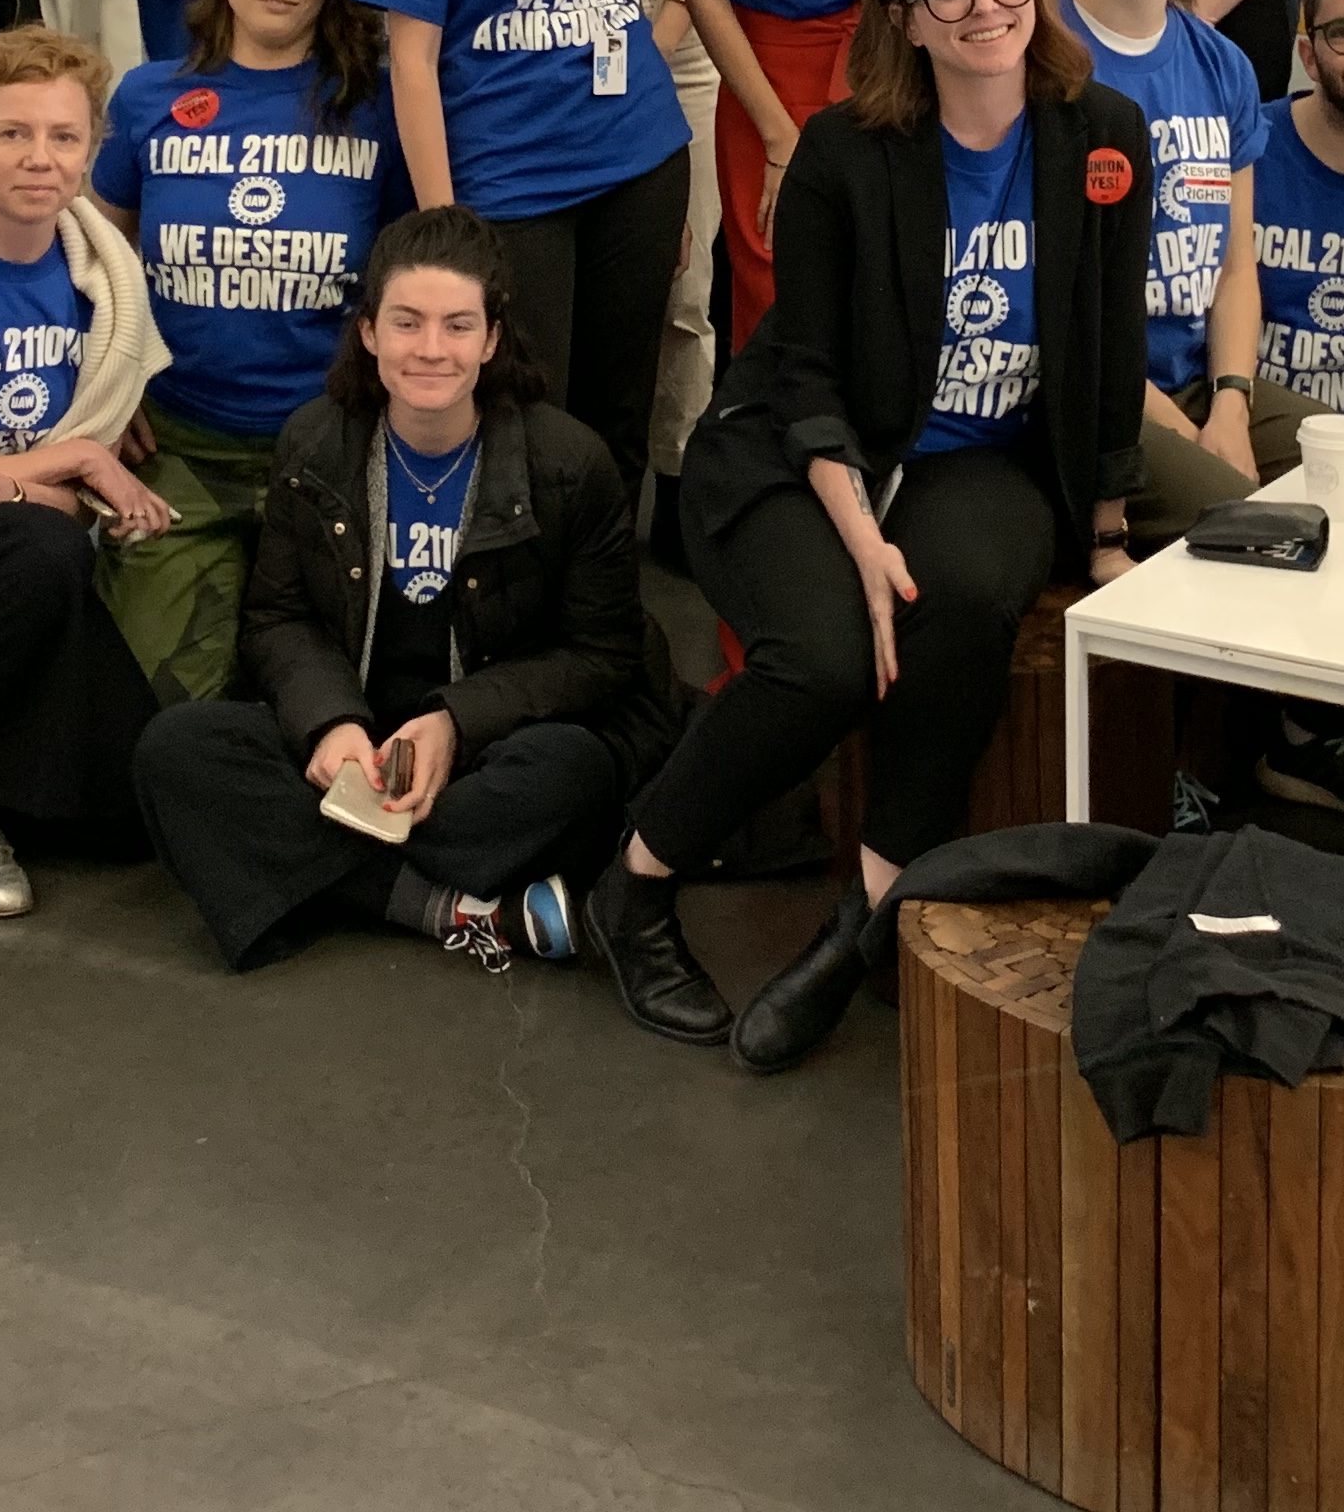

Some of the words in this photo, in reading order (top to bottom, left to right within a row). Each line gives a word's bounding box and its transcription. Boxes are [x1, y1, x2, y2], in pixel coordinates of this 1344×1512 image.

[472, 16, 493, 50] A
[495, 9, 552, 51] FAIR
[150, 135, 234, 175] LOCAL
[239, 134, 308, 175] 2110
[313, 135, 379, 180] UAW
[1087, 159, 1125, 173] UNION
[1090, 175, 1120, 190] YES!
[242, 193, 271, 208] UAW
[159, 223, 206, 266] WE
[213, 226, 348, 273] DESERVE
[4, 325, 66, 373] 2110
[10, 394, 36, 411] UAW
